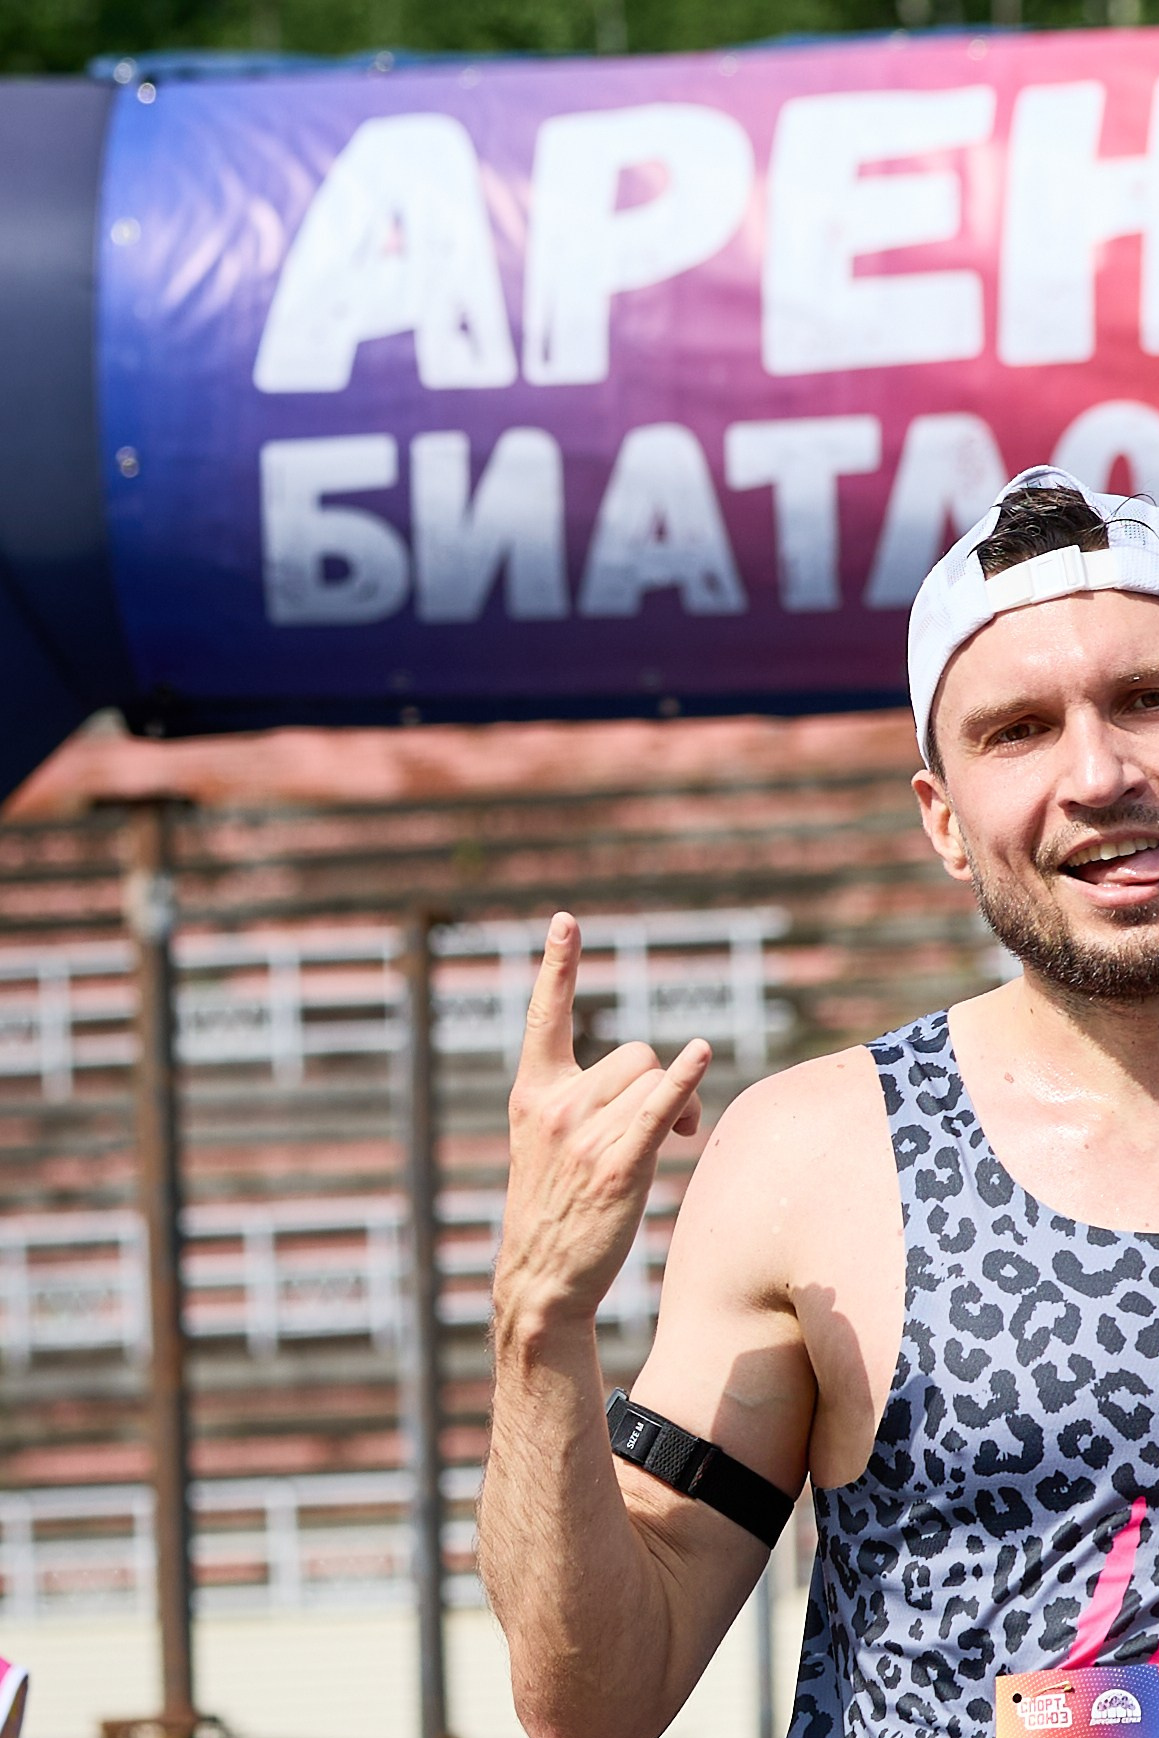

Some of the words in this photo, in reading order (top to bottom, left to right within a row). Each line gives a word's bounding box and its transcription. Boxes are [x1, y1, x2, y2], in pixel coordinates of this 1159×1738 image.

[626, 1430, 640, 1450] SIZE
[635, 1421, 645, 1432] M
[1021, 1698, 1062, 1714] СПОРТ
[1028, 1711, 1069, 1727] СОЮЗ
